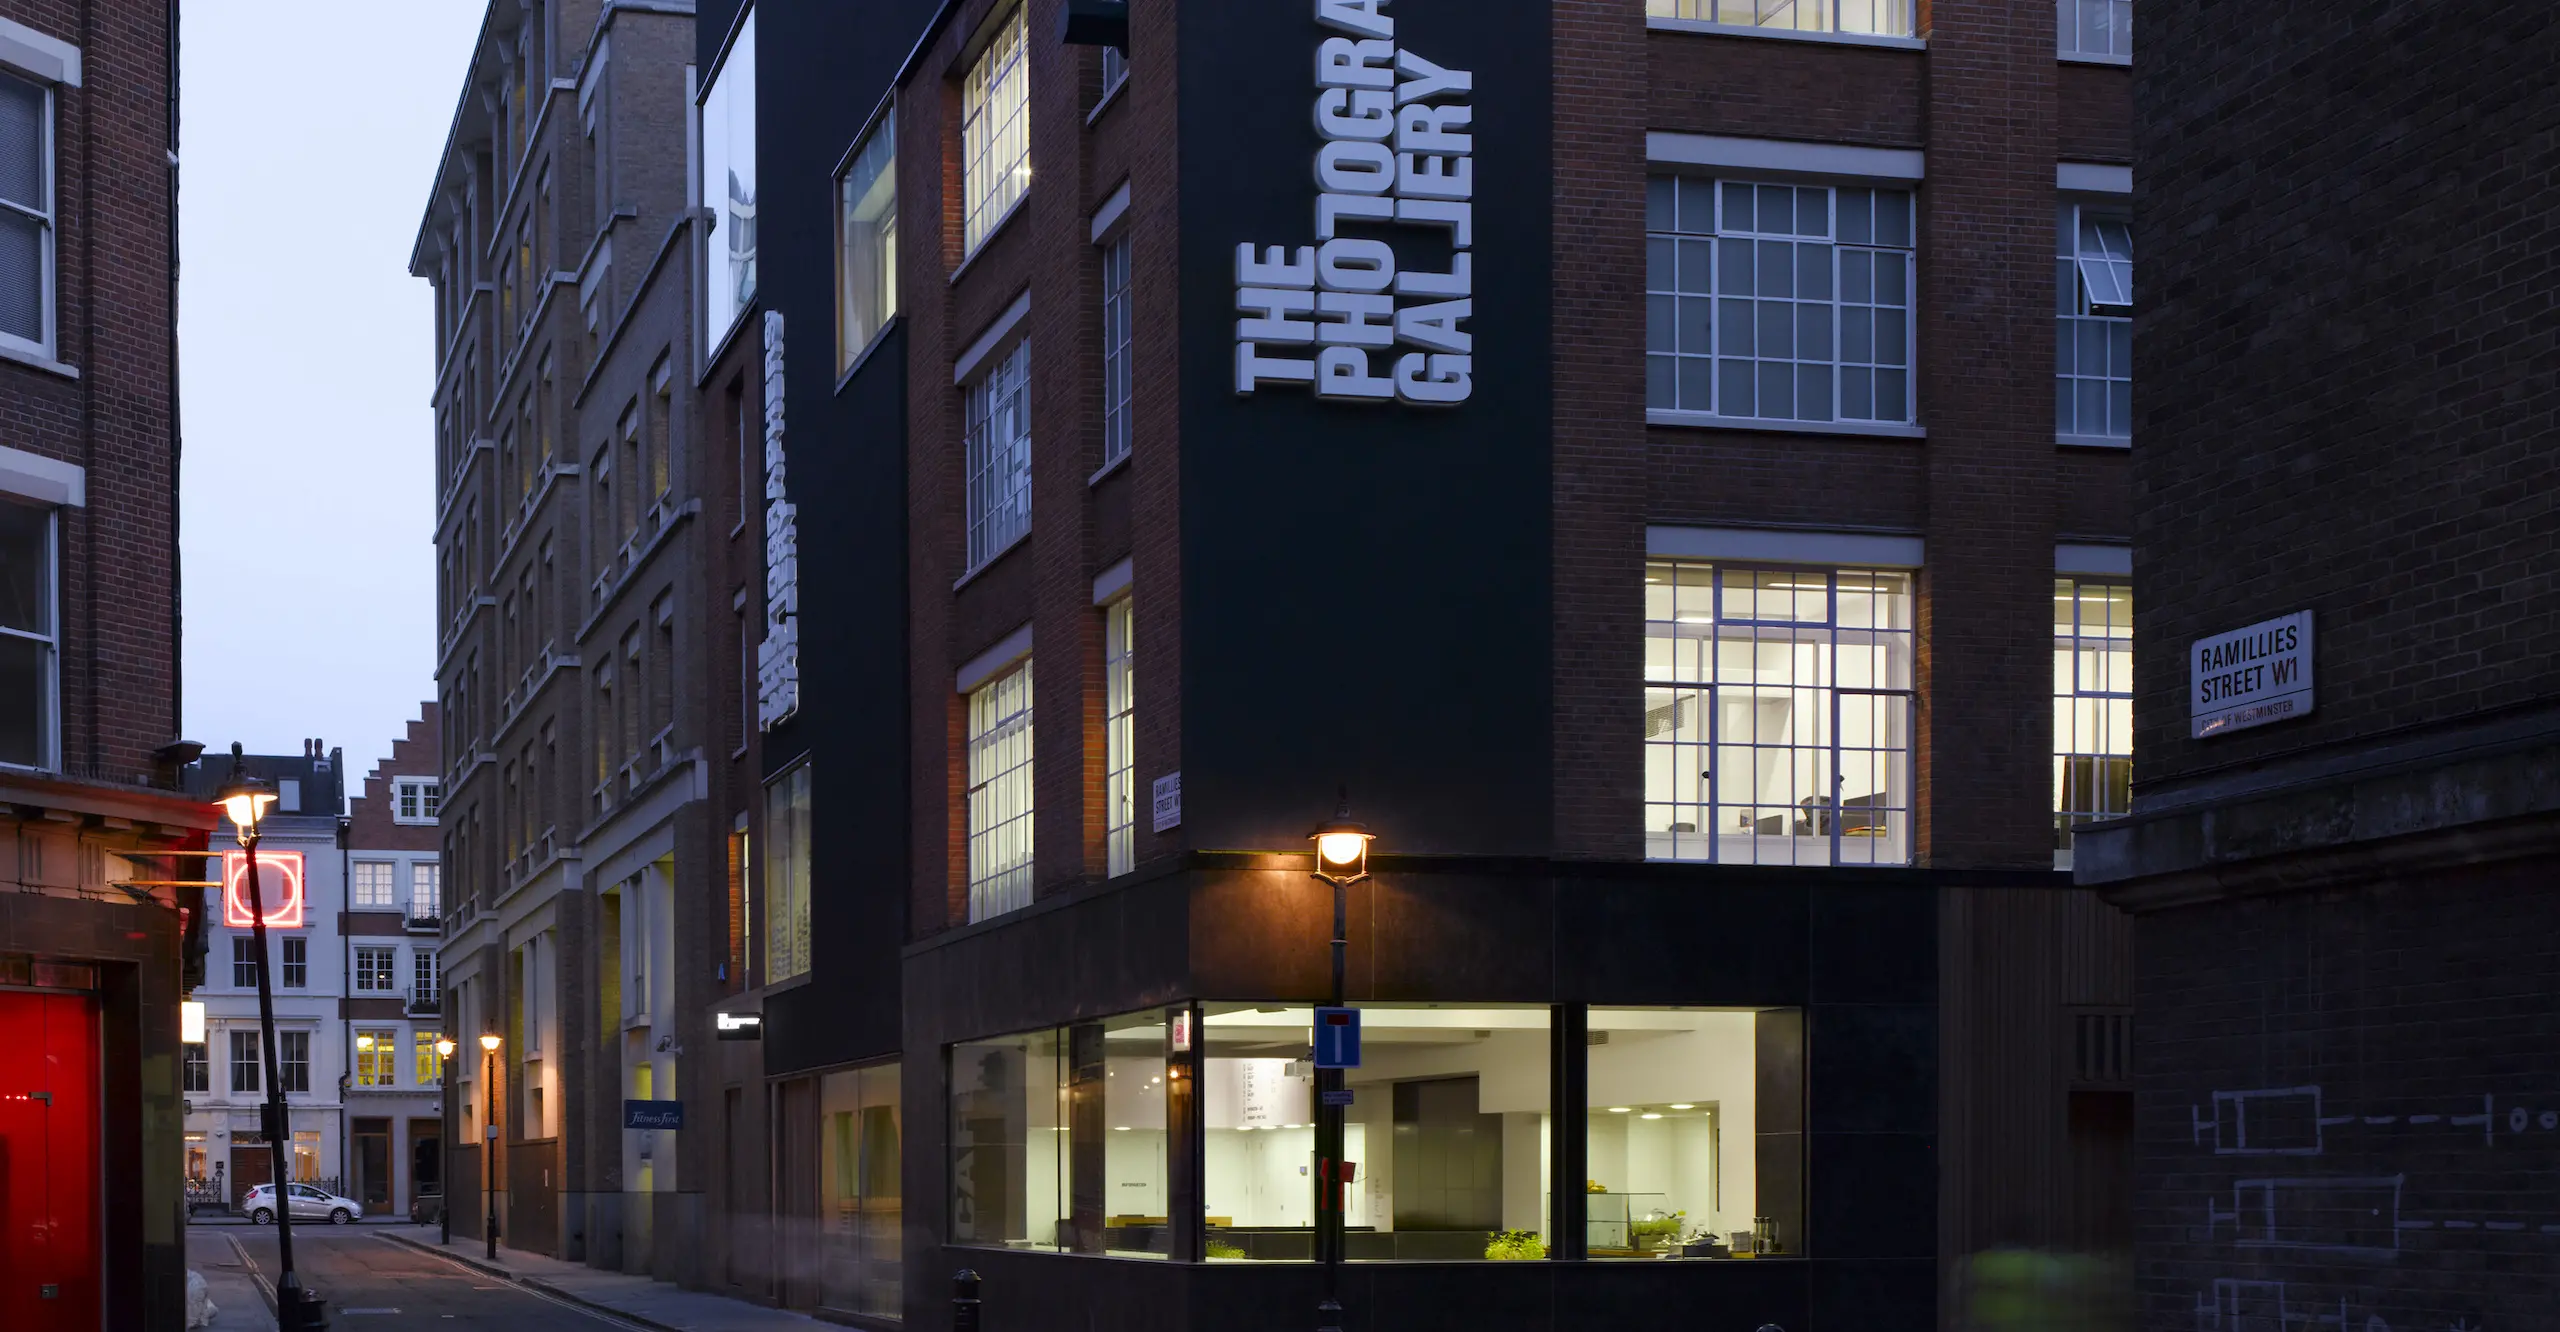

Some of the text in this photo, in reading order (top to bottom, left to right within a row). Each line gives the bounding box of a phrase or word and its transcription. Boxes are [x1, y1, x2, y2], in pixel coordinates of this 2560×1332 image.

[1395, 48, 1473, 407] GALLERY
[1235, 241, 1315, 396] THE
[2201, 625, 2297, 673] RAMILLIES
[2201, 656, 2298, 704] STREET W1
[2223, 714, 2232, 726] OF
[2234, 701, 2293, 724] WESTMINSTER
[1156, 777, 1181, 798] RAMILLIES
[1156, 796, 1173, 814] STREET
